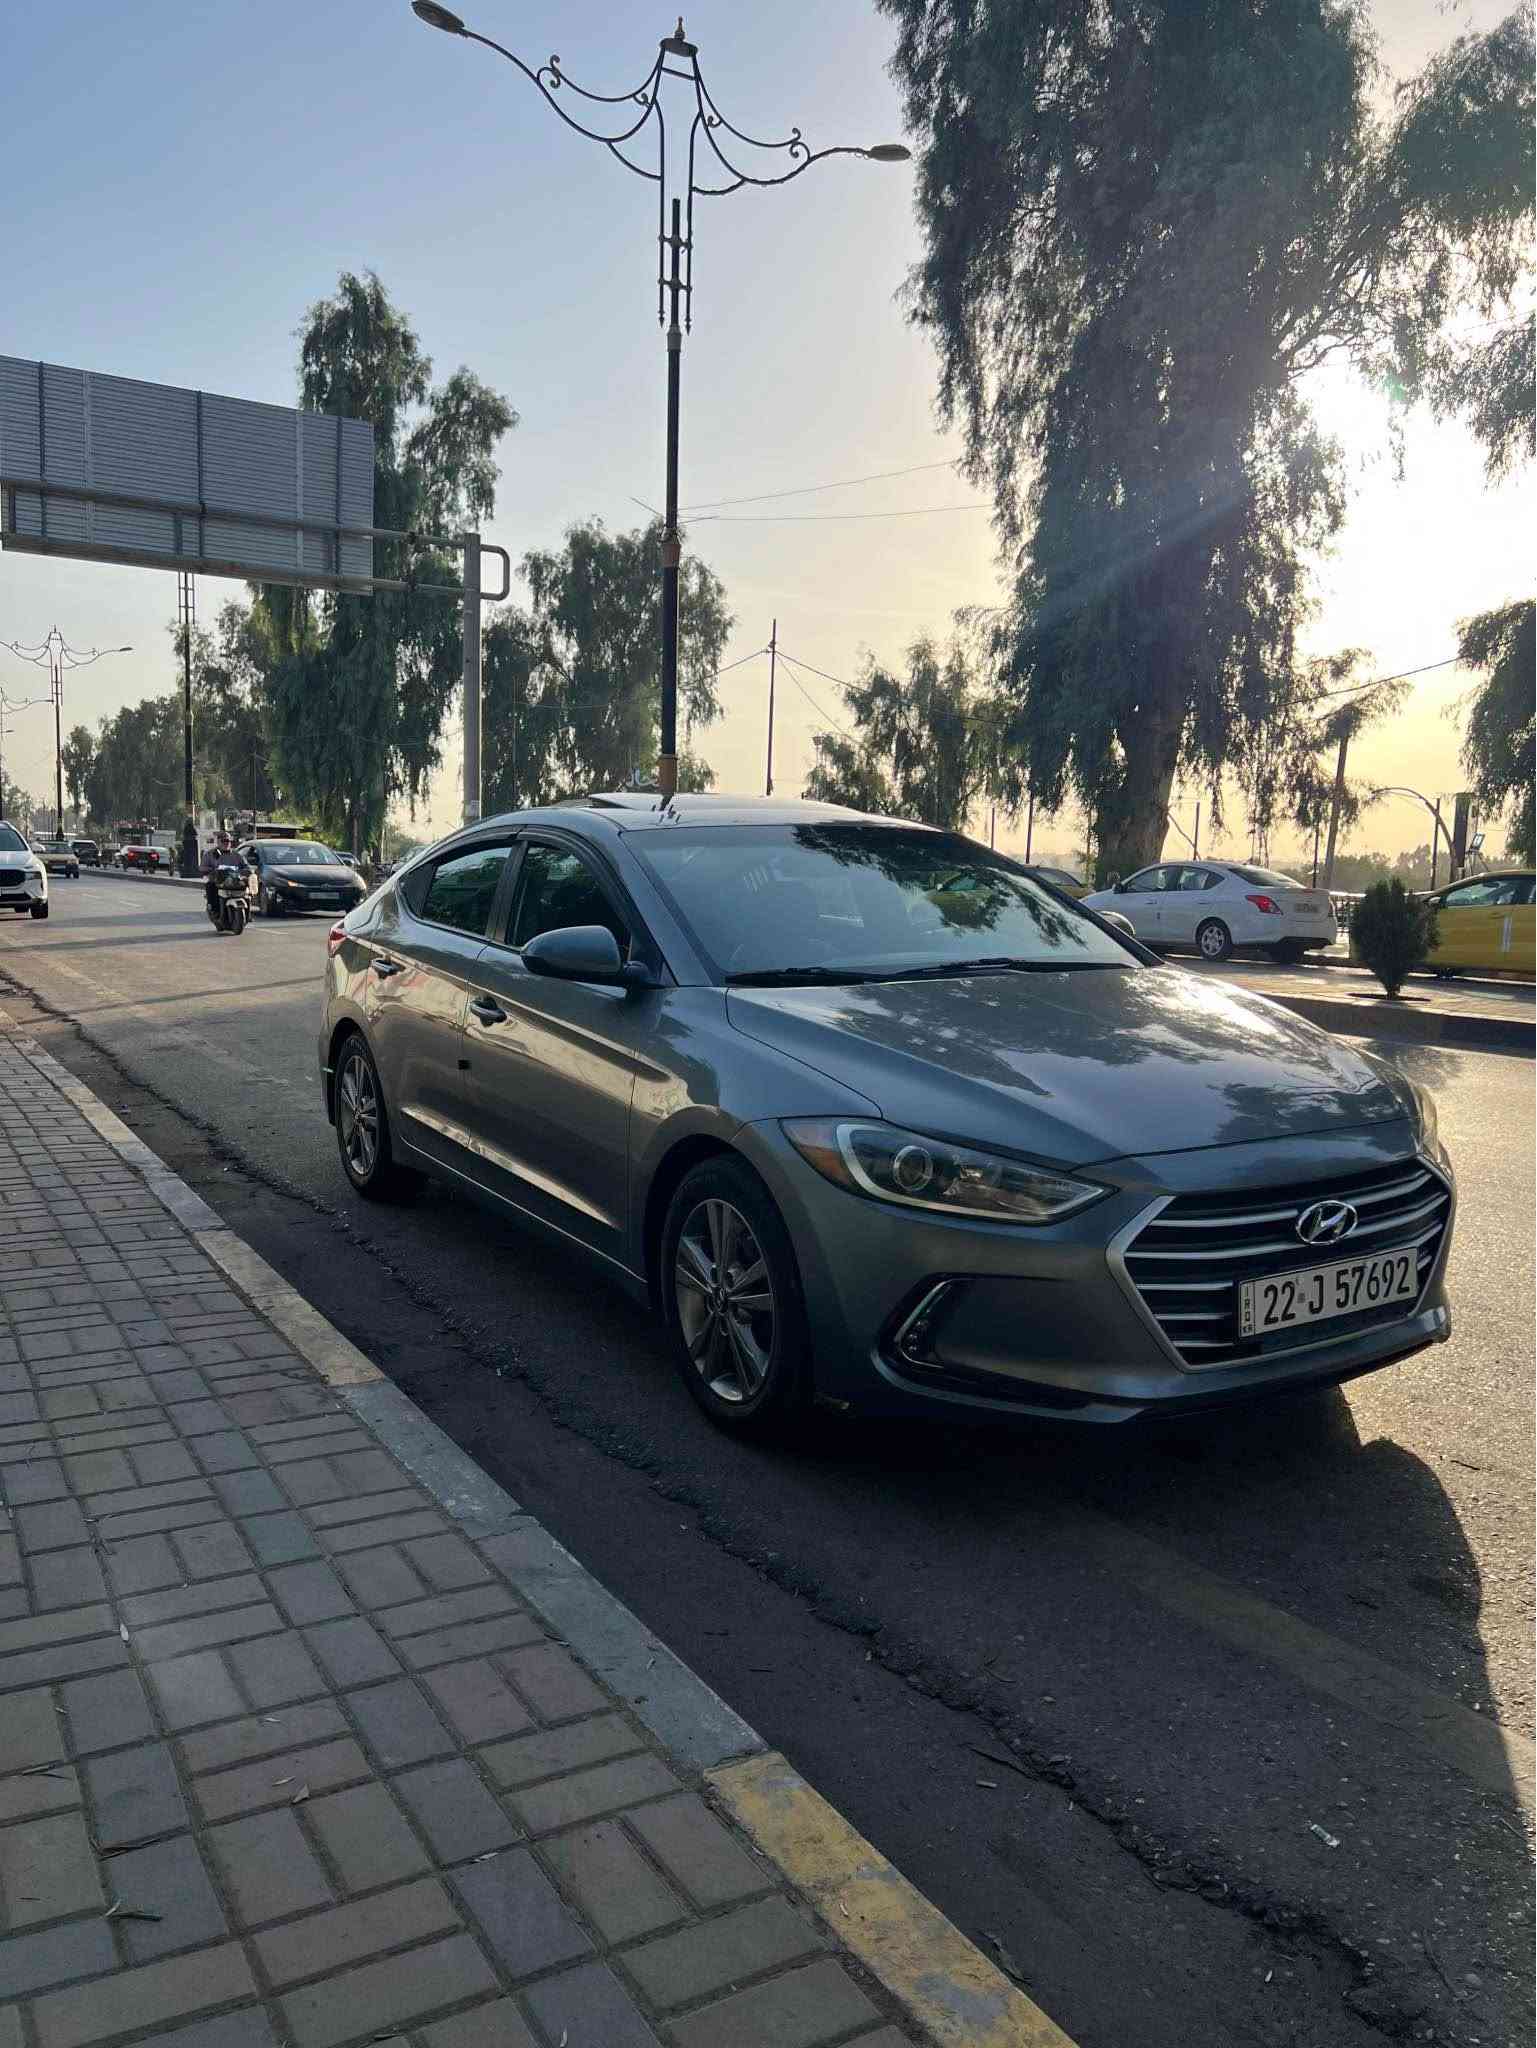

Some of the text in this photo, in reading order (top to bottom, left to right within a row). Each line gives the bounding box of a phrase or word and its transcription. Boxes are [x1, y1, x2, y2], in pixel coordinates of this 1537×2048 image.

[1264, 1256, 1409, 1325] 22 J 57692
